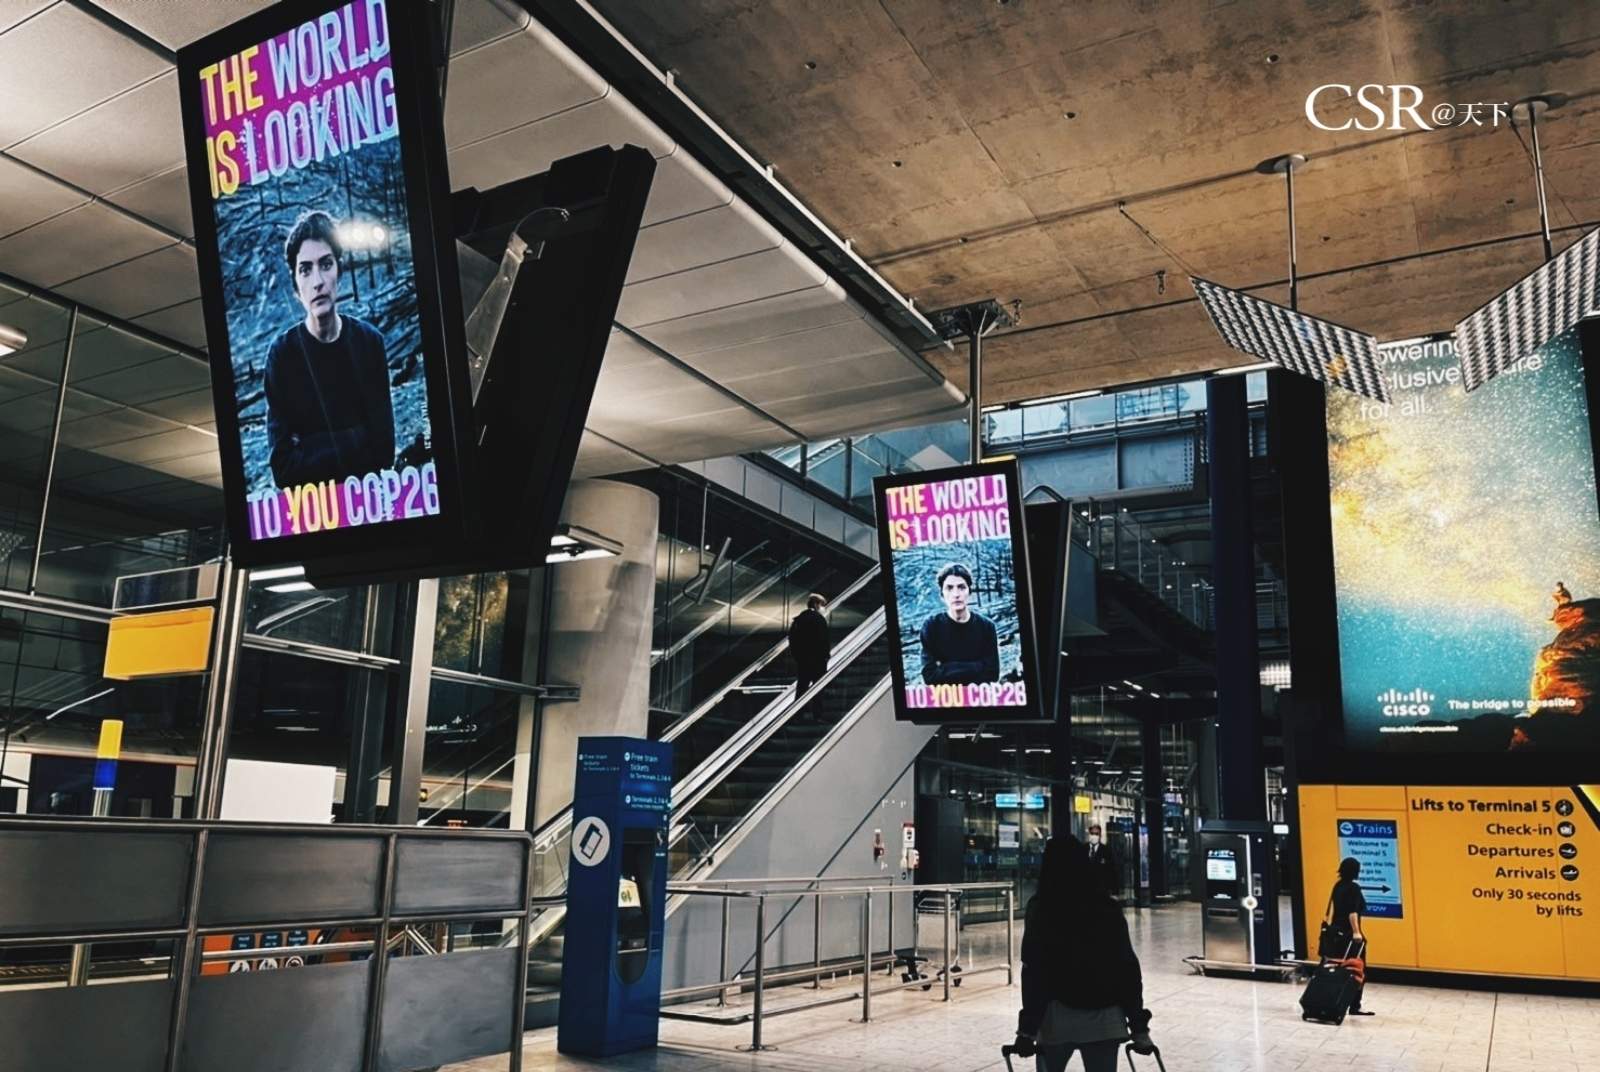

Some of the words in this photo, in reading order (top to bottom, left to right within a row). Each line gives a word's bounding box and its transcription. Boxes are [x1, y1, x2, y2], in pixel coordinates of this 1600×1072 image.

[200, 45, 264, 126] THE
[268, 0, 391, 100] WORLD
[206, 130, 240, 200] IS
[244, 67, 399, 186] LOOKING
[246, 487, 282, 540] TO
[284, 479, 340, 535] YOU
[344, 462, 441, 527] COP26
[886, 484, 928, 517] THE
[931, 473, 1008, 511] WORLD
[888, 519, 911, 550] IS
[913, 508, 1011, 547] LOOKING
[905, 685, 928, 708] TO
[930, 684, 964, 708] YOU
[967, 681, 1027, 707] COP26
[1448, 700, 1470, 710] The
[1472, 699, 1509, 711] bridge
[1511, 699, 1524, 709] to
[1527, 697, 1577, 711] possible
[1411, 799, 1444, 812] Lifts
[1448, 800, 1464, 812] to
[1468, 799, 1537, 813] Terminal
[1542, 800, 1551, 812] 5
[1356, 822, 1393, 834] Trains
[1486, 822, 1552, 836] Check-in
[1347, 839, 1379, 847] Welcome
[1467, 844, 1554, 859] Departures
[1495, 866, 1556, 880] Arrivals
[1472, 888, 1504, 901] Only
[1507, 889, 1523, 900] 30
[1526, 889, 1581, 901] seconds
[1536, 904, 1553, 917] by
[1557, 905, 1583, 917] lifts
